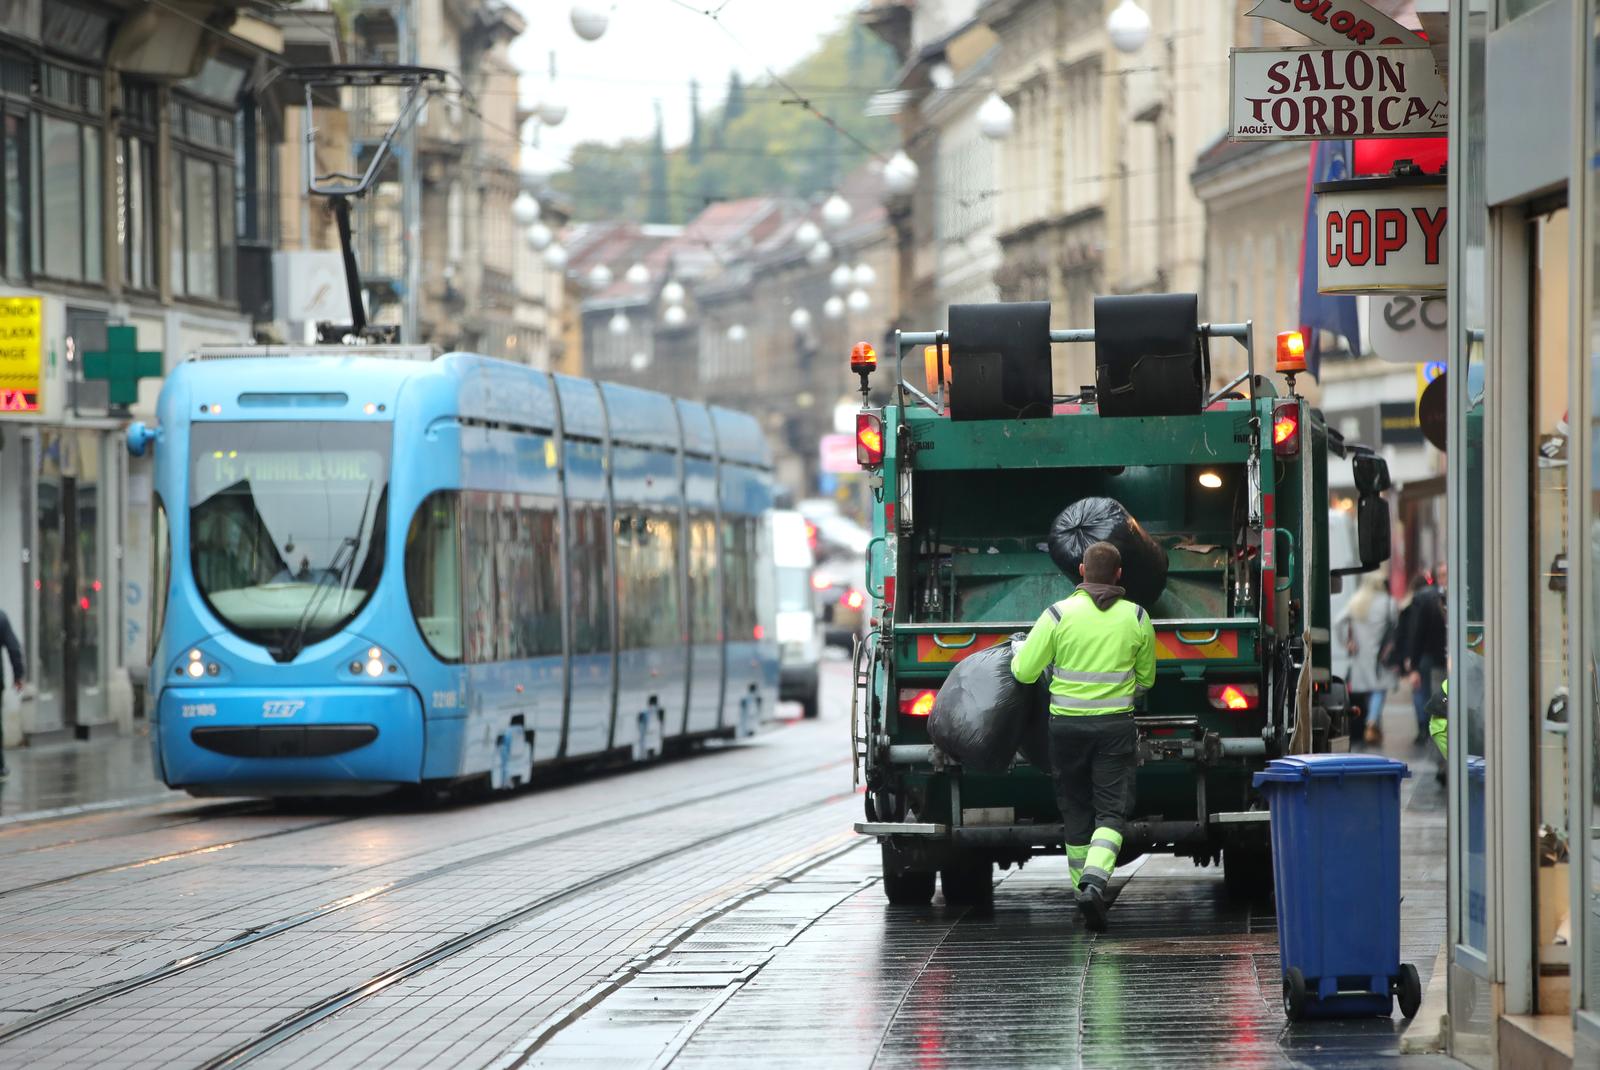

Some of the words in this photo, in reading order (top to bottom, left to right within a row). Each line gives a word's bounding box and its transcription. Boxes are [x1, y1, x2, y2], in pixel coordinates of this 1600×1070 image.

[1281, 0, 1376, 45] OLOR
[1267, 50, 1407, 94] SALON
[1237, 123, 1273, 134] JAGUŠT
[1244, 95, 1430, 135] TORBICA
[1326, 206, 1447, 267] COPY
